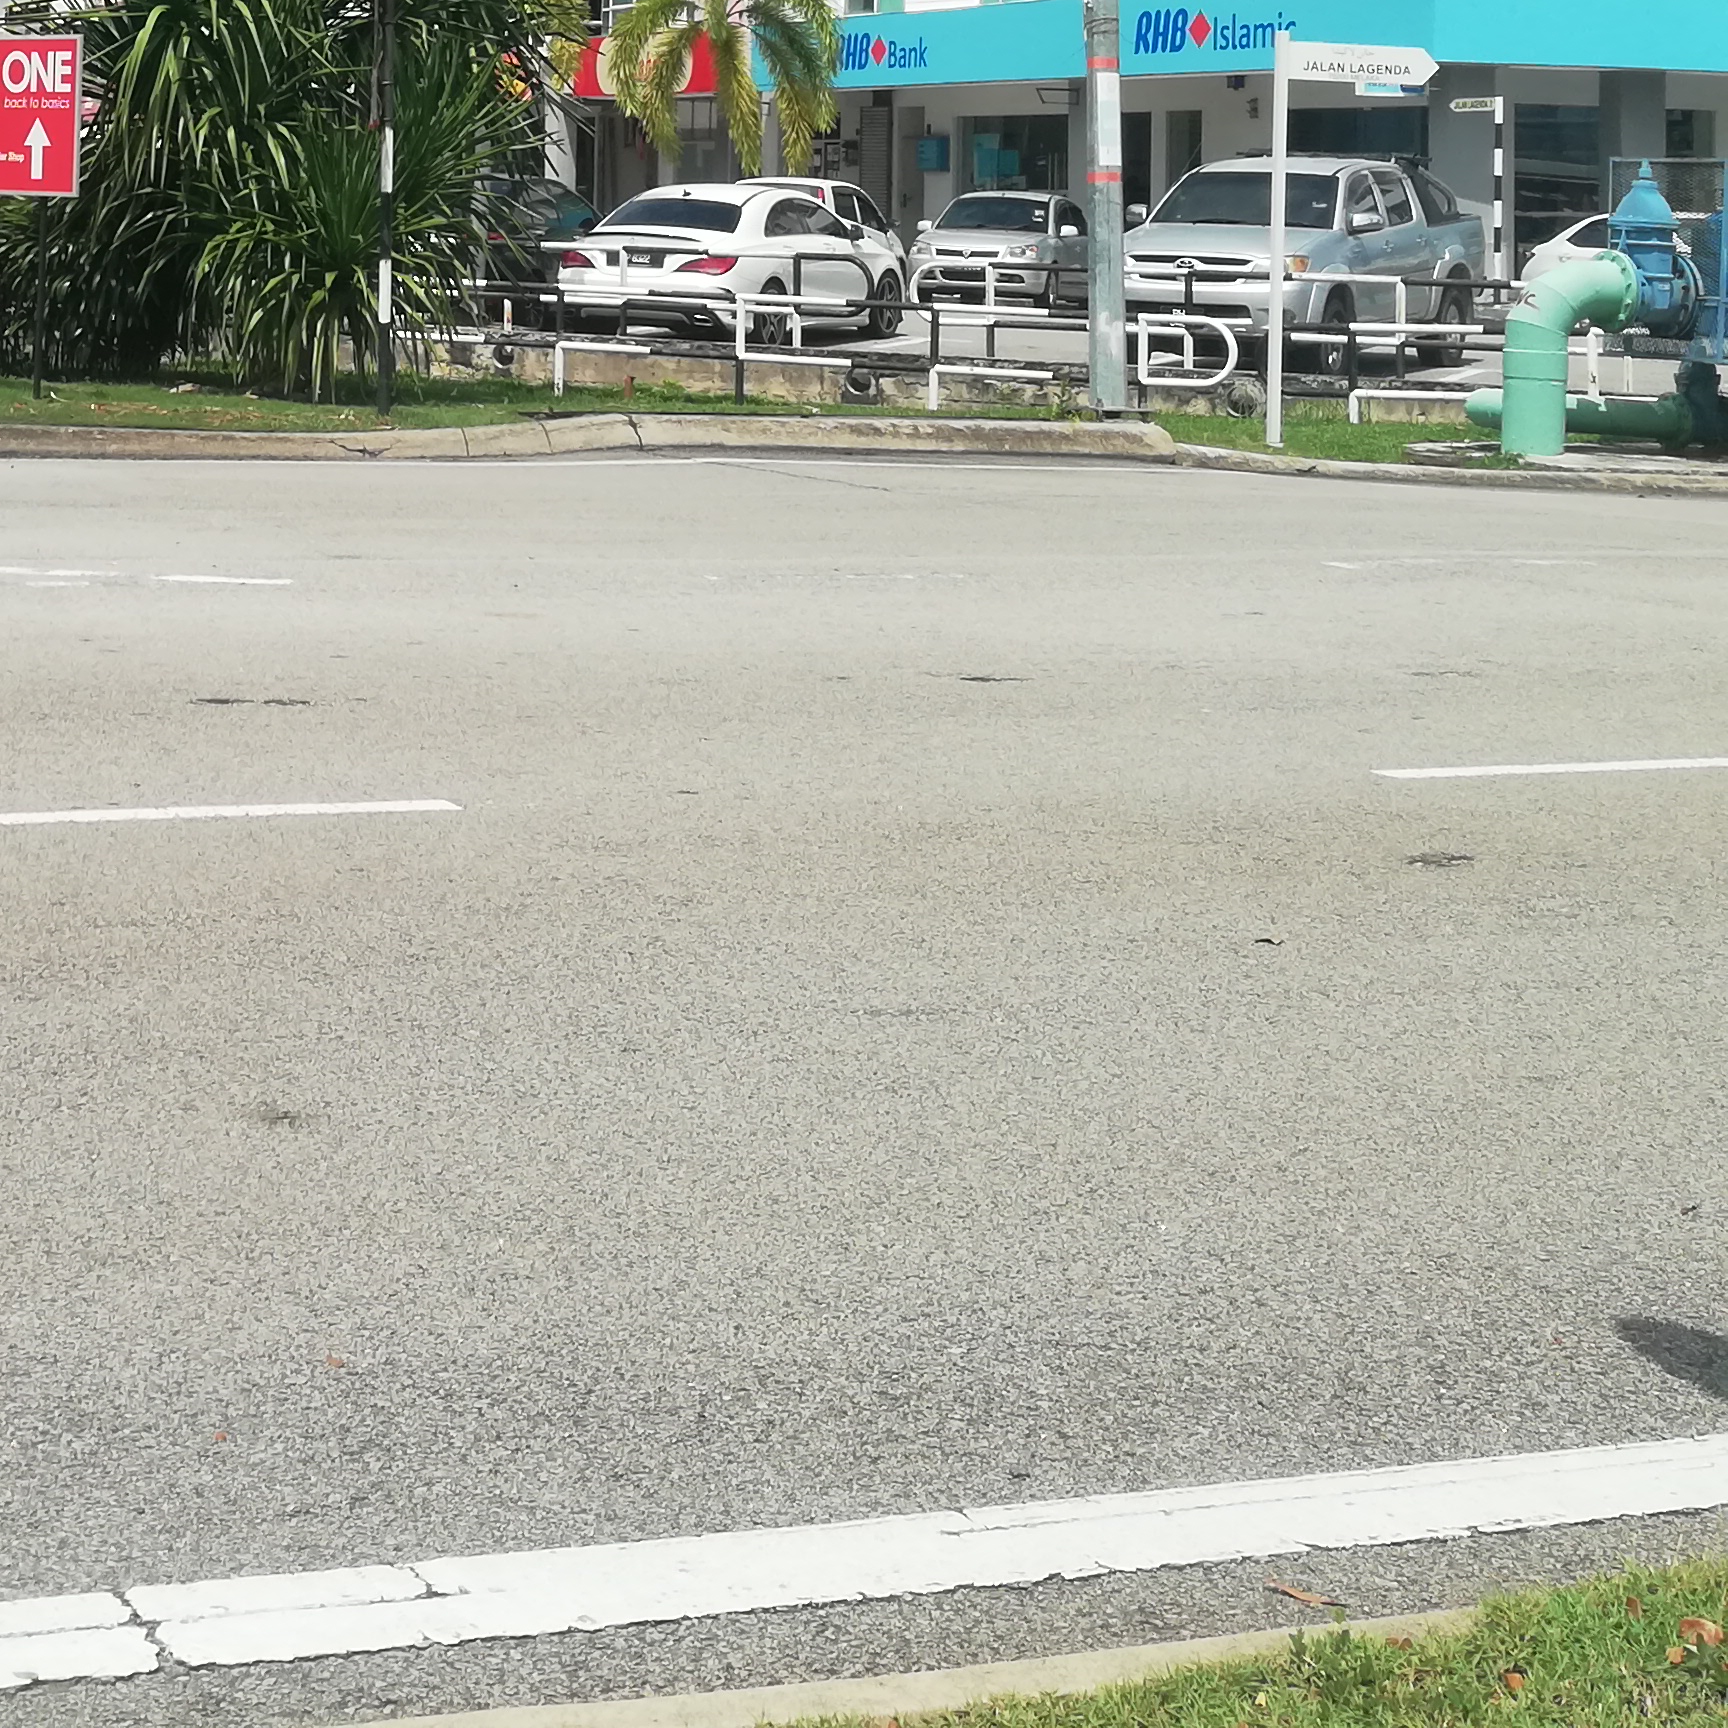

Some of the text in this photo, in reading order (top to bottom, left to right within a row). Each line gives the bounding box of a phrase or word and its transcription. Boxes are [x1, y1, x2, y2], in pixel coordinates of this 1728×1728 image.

[1134, 8, 1189, 55] RHB
[888, 36, 928, 69] Bank
[1303, 60, 1412, 76] JALAN LAGENDA
[3, 95, 70, 109] back to basics
